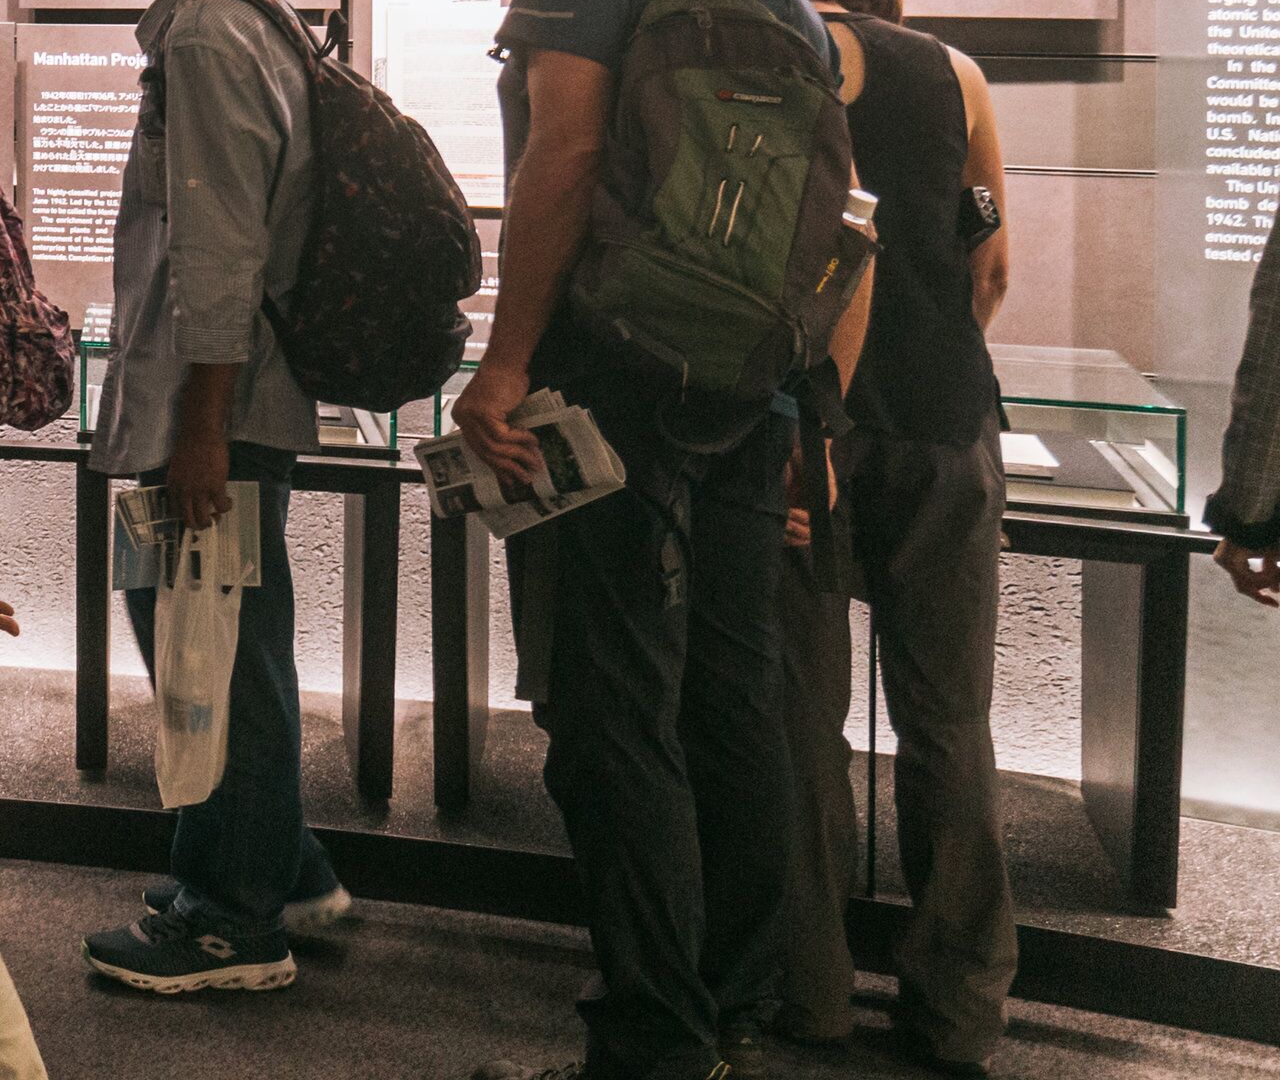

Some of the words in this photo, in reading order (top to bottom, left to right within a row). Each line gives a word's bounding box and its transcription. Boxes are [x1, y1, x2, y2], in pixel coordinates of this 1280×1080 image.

[1262, 9, 1280, 21] bo
[1239, 26, 1280, 38] Unite
[33, 52, 108, 66] Manhattan
[110, 52, 147, 69] Proje
[1206, 76, 1280, 90] Committe
[1248, 129, 1280, 142] Nati
[1256, 181, 1279, 194] Un
[1257, 199, 1277, 211] de
[1252, 215, 1272, 228] Th
